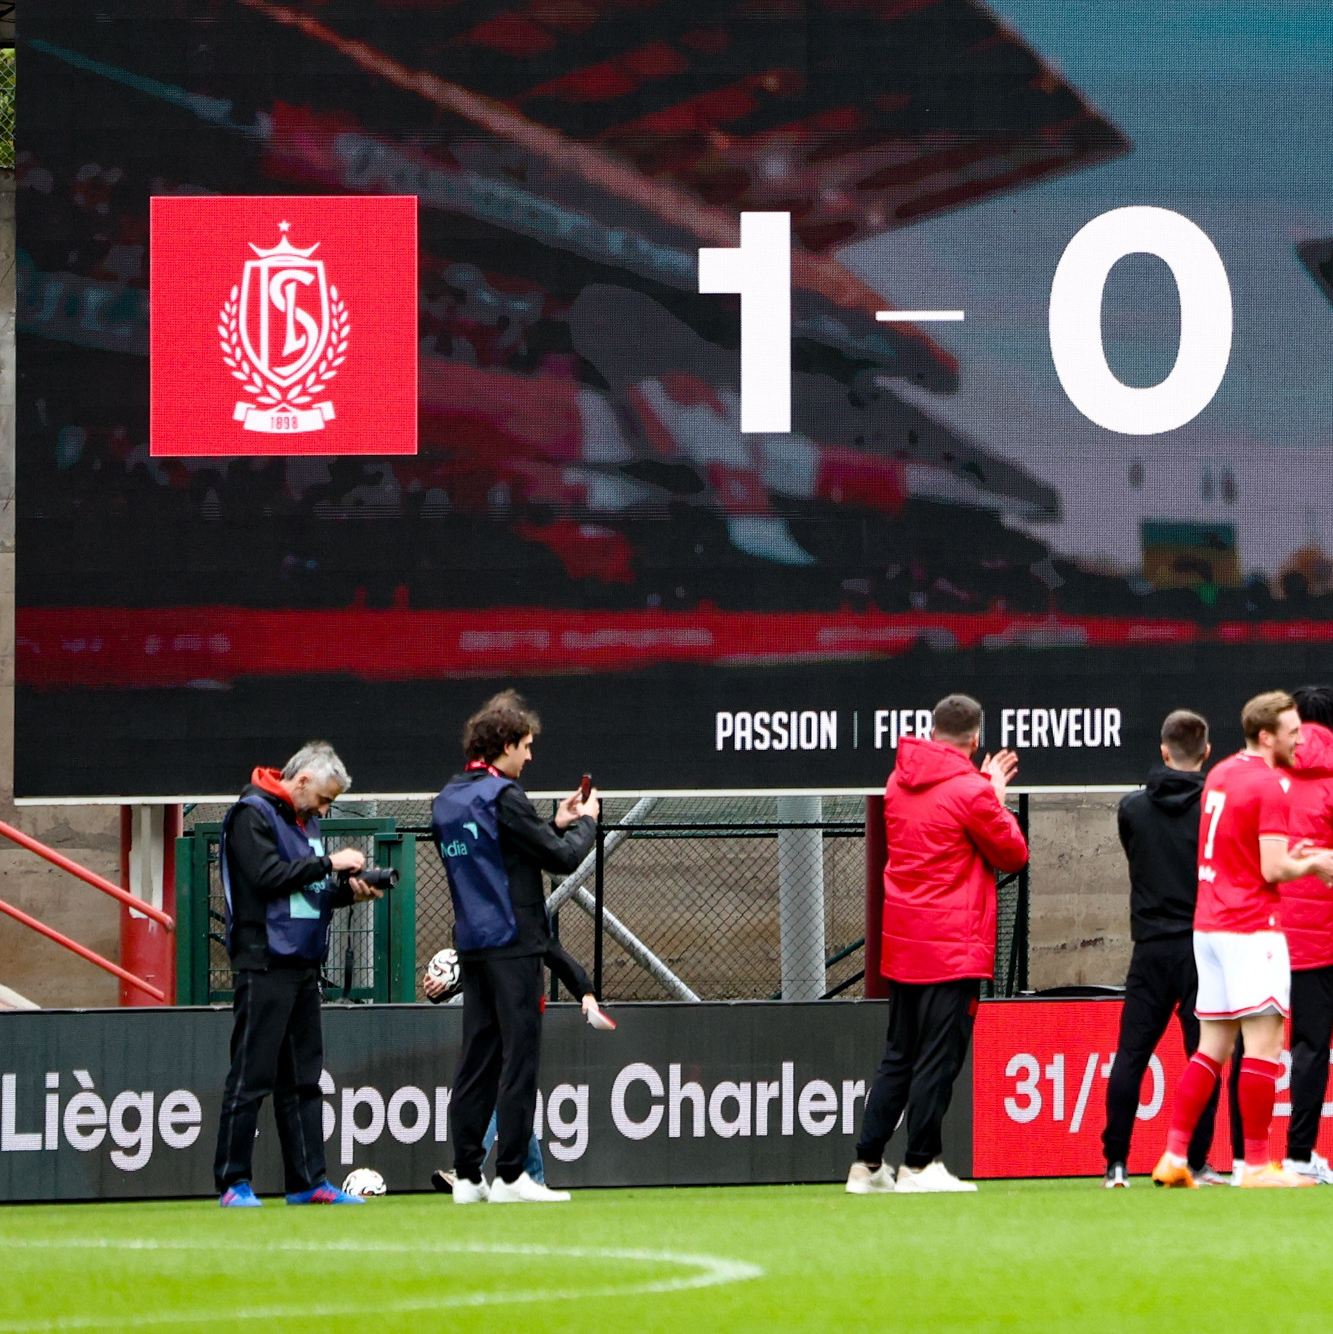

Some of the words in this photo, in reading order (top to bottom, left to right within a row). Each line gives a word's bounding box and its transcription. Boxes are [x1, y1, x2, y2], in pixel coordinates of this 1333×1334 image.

[697, 211, 792, 434] 1
[1048, 205, 1234, 435] 0
[270, 416, 298, 429] 1898
[715, 709, 838, 751] PASSION
[874, 709, 936, 749] FIER
[1001, 707, 1122, 749] FERVEUR
[1204, 789, 1227, 860] 7
[0, 1068, 202, 1171] Liège
[611, 1060, 905, 1141] Charler
[1004, 1052, 1164, 1134] 31/0
